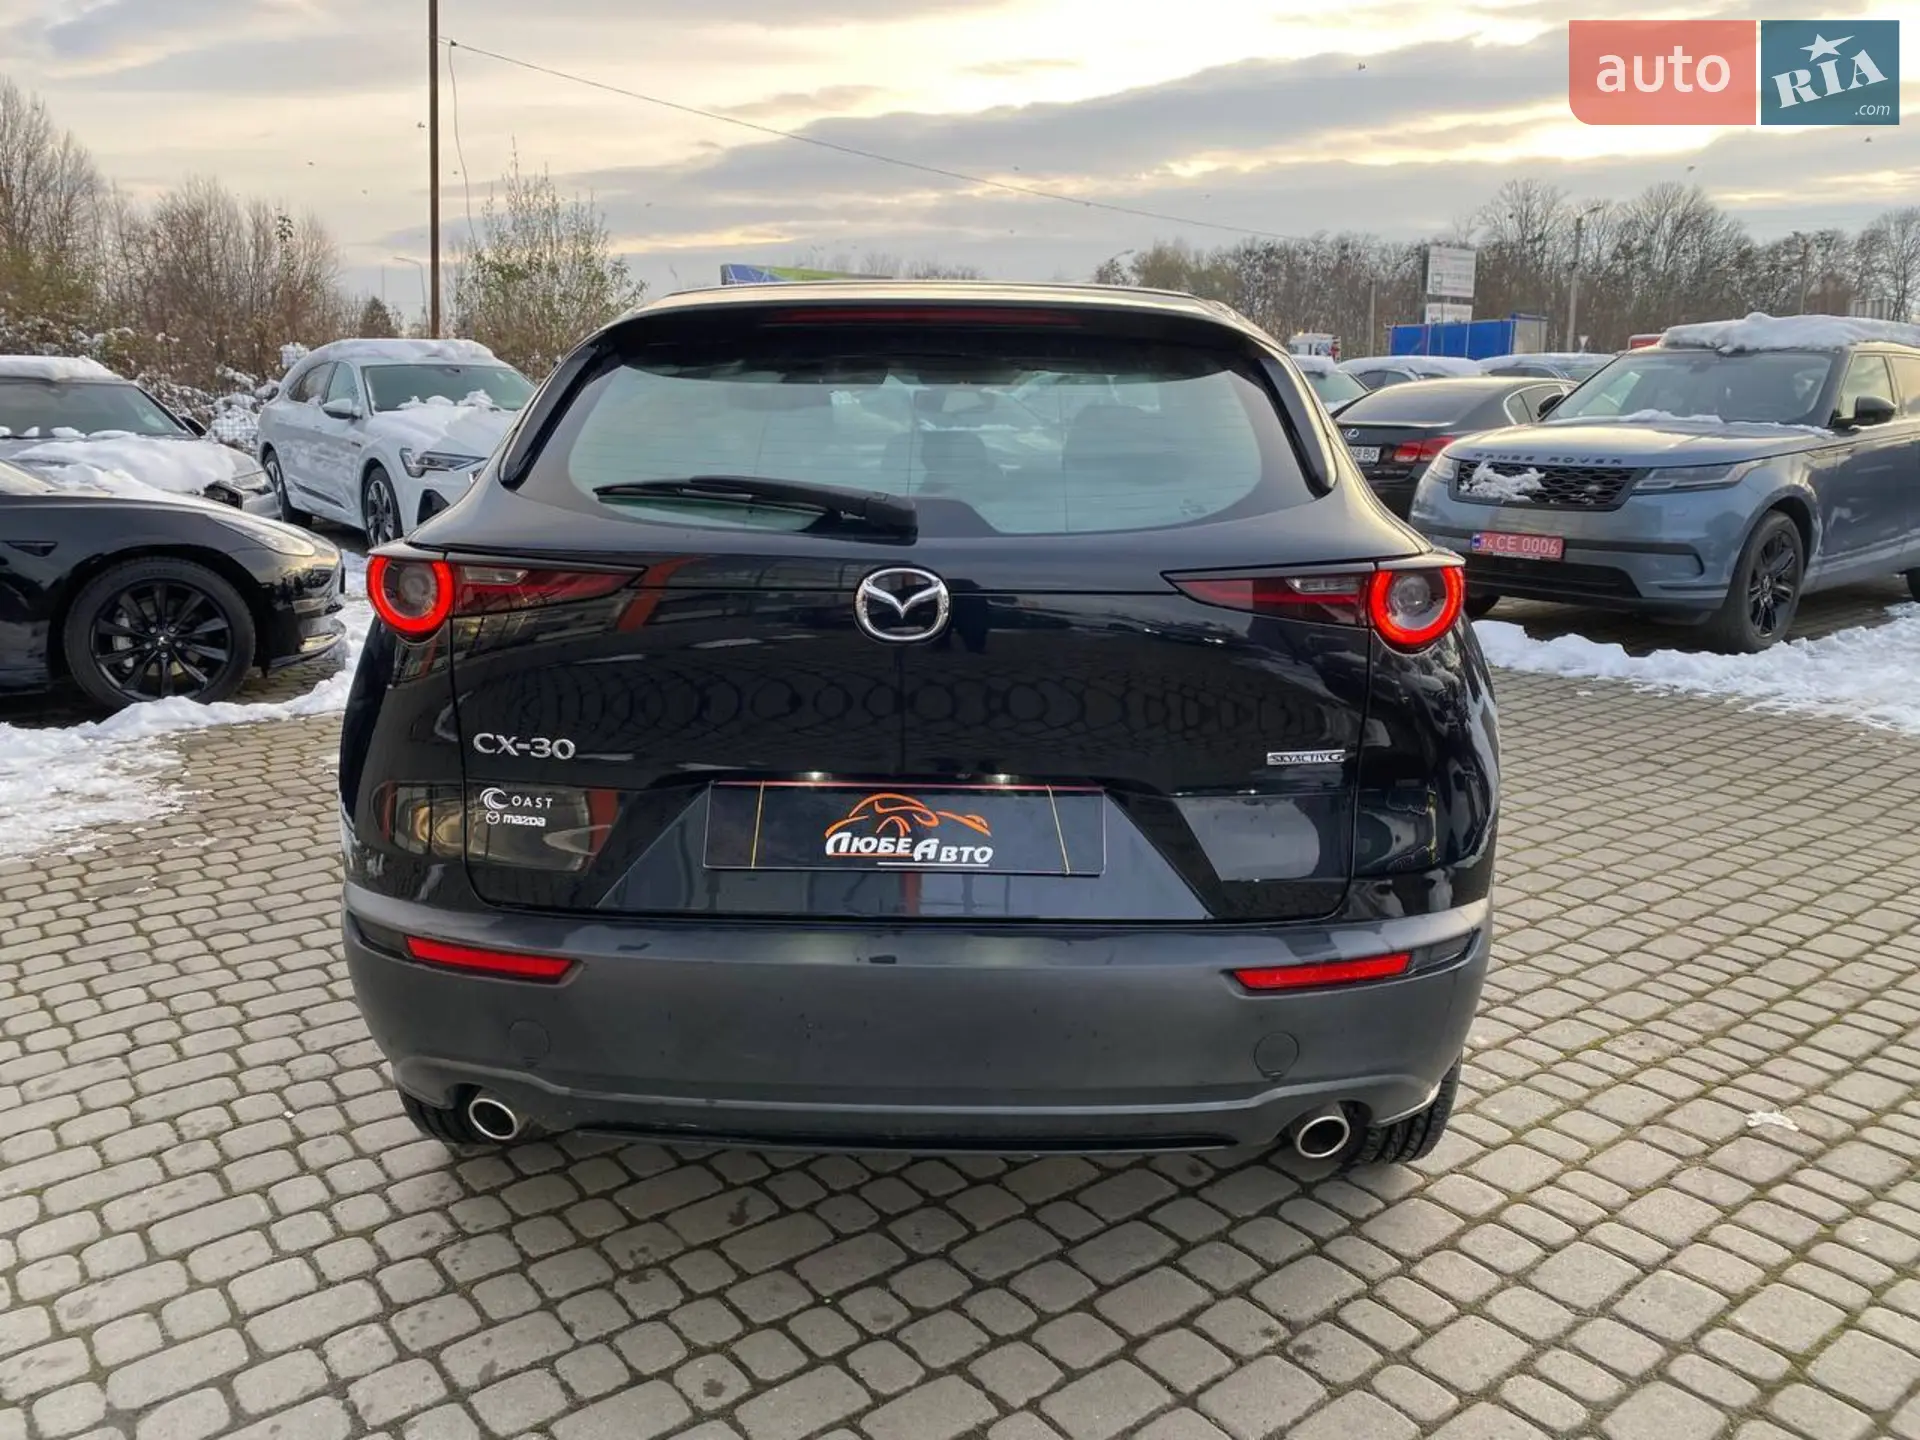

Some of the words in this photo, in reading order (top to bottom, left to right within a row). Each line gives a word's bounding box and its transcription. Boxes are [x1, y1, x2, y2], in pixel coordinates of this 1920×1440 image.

[1474, 452, 1535, 462] RANGE
[1548, 456, 1623, 465] ROVER
[1496, 535, 1518, 550] CE
[1522, 537, 1558, 555] 0006
[473, 732, 576, 760] CX-30
